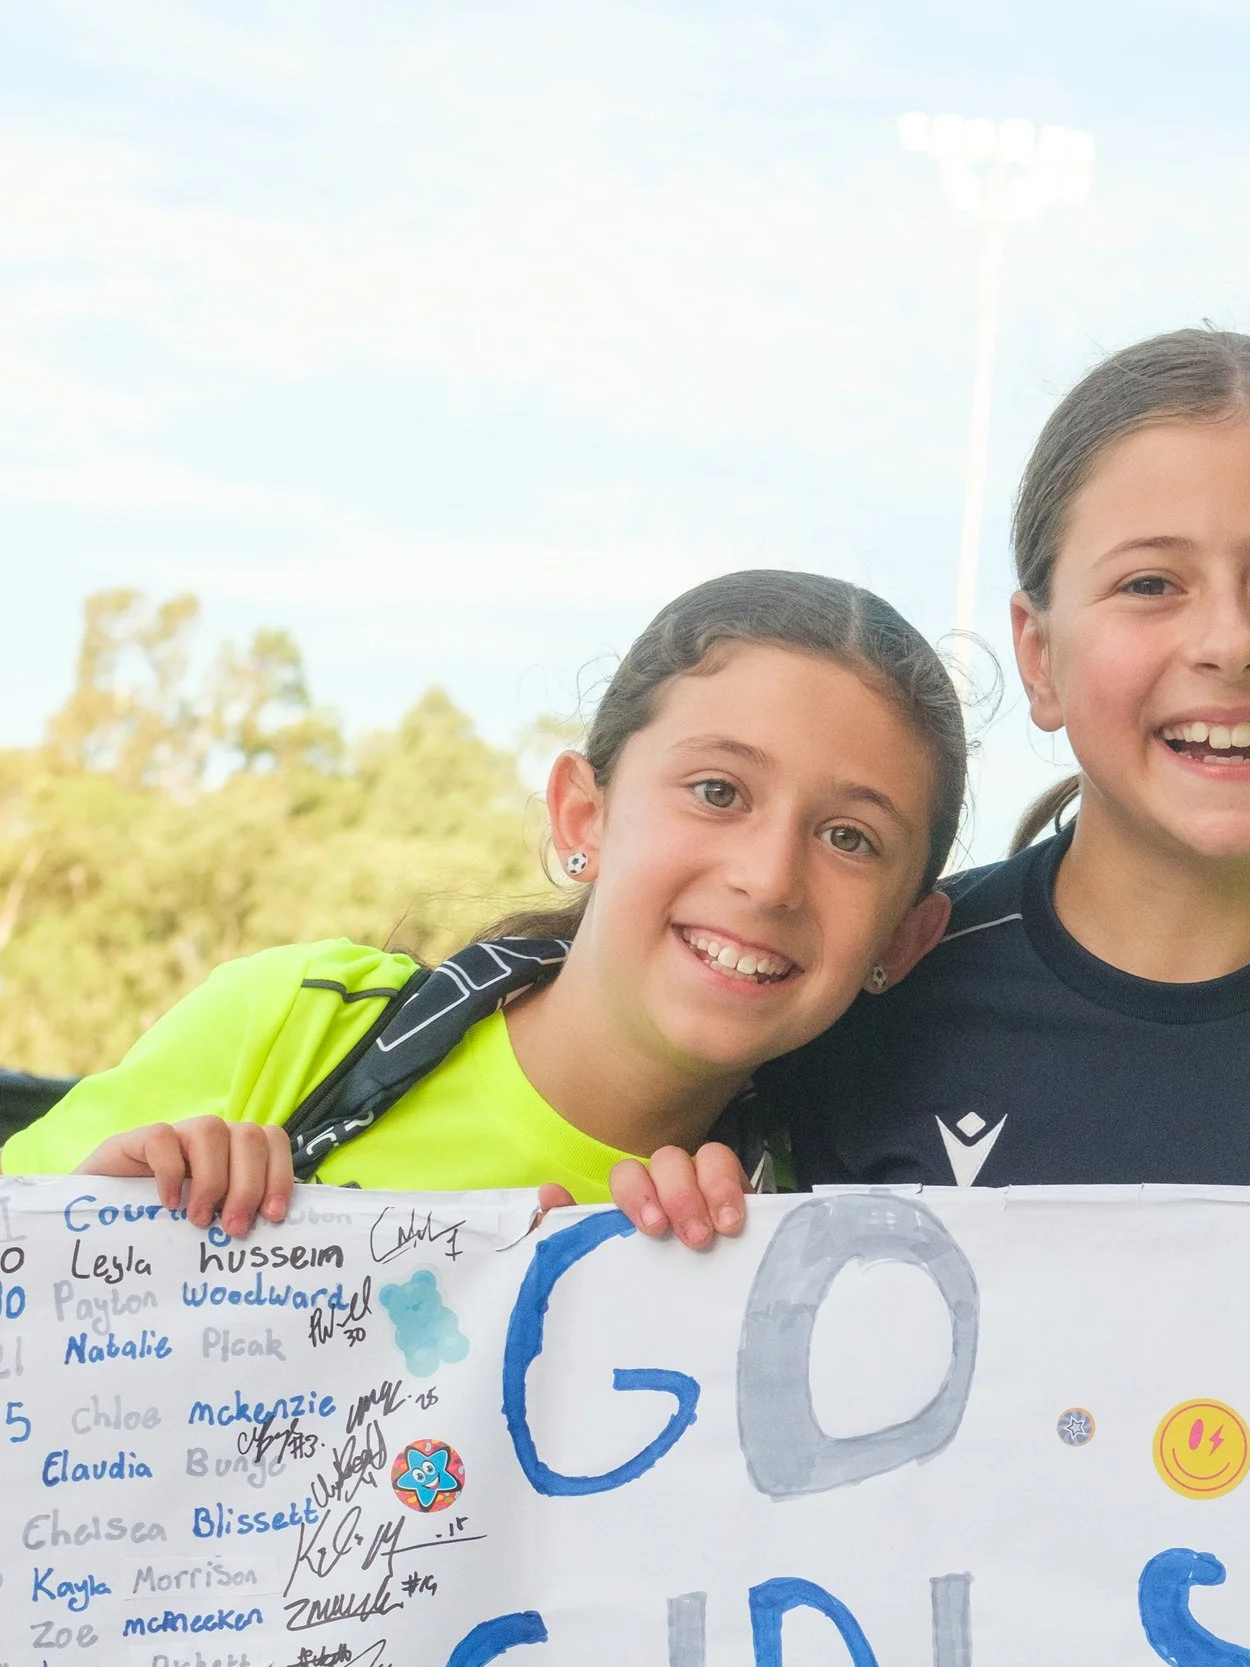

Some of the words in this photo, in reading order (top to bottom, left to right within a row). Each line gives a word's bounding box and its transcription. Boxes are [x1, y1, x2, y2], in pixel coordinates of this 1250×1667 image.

[71, 1238, 152, 1285] Leyla
[53, 1279, 159, 1337] Payton
[64, 1329, 173, 1365] Natalie
[502, 1187, 981, 1503] GO
[193, 1498, 319, 1539] Blissett
[32, 1567, 112, 1612] Kayla
[132, 1560, 257, 1595] Morrison
[30, 1620, 98, 1649] Zoe
